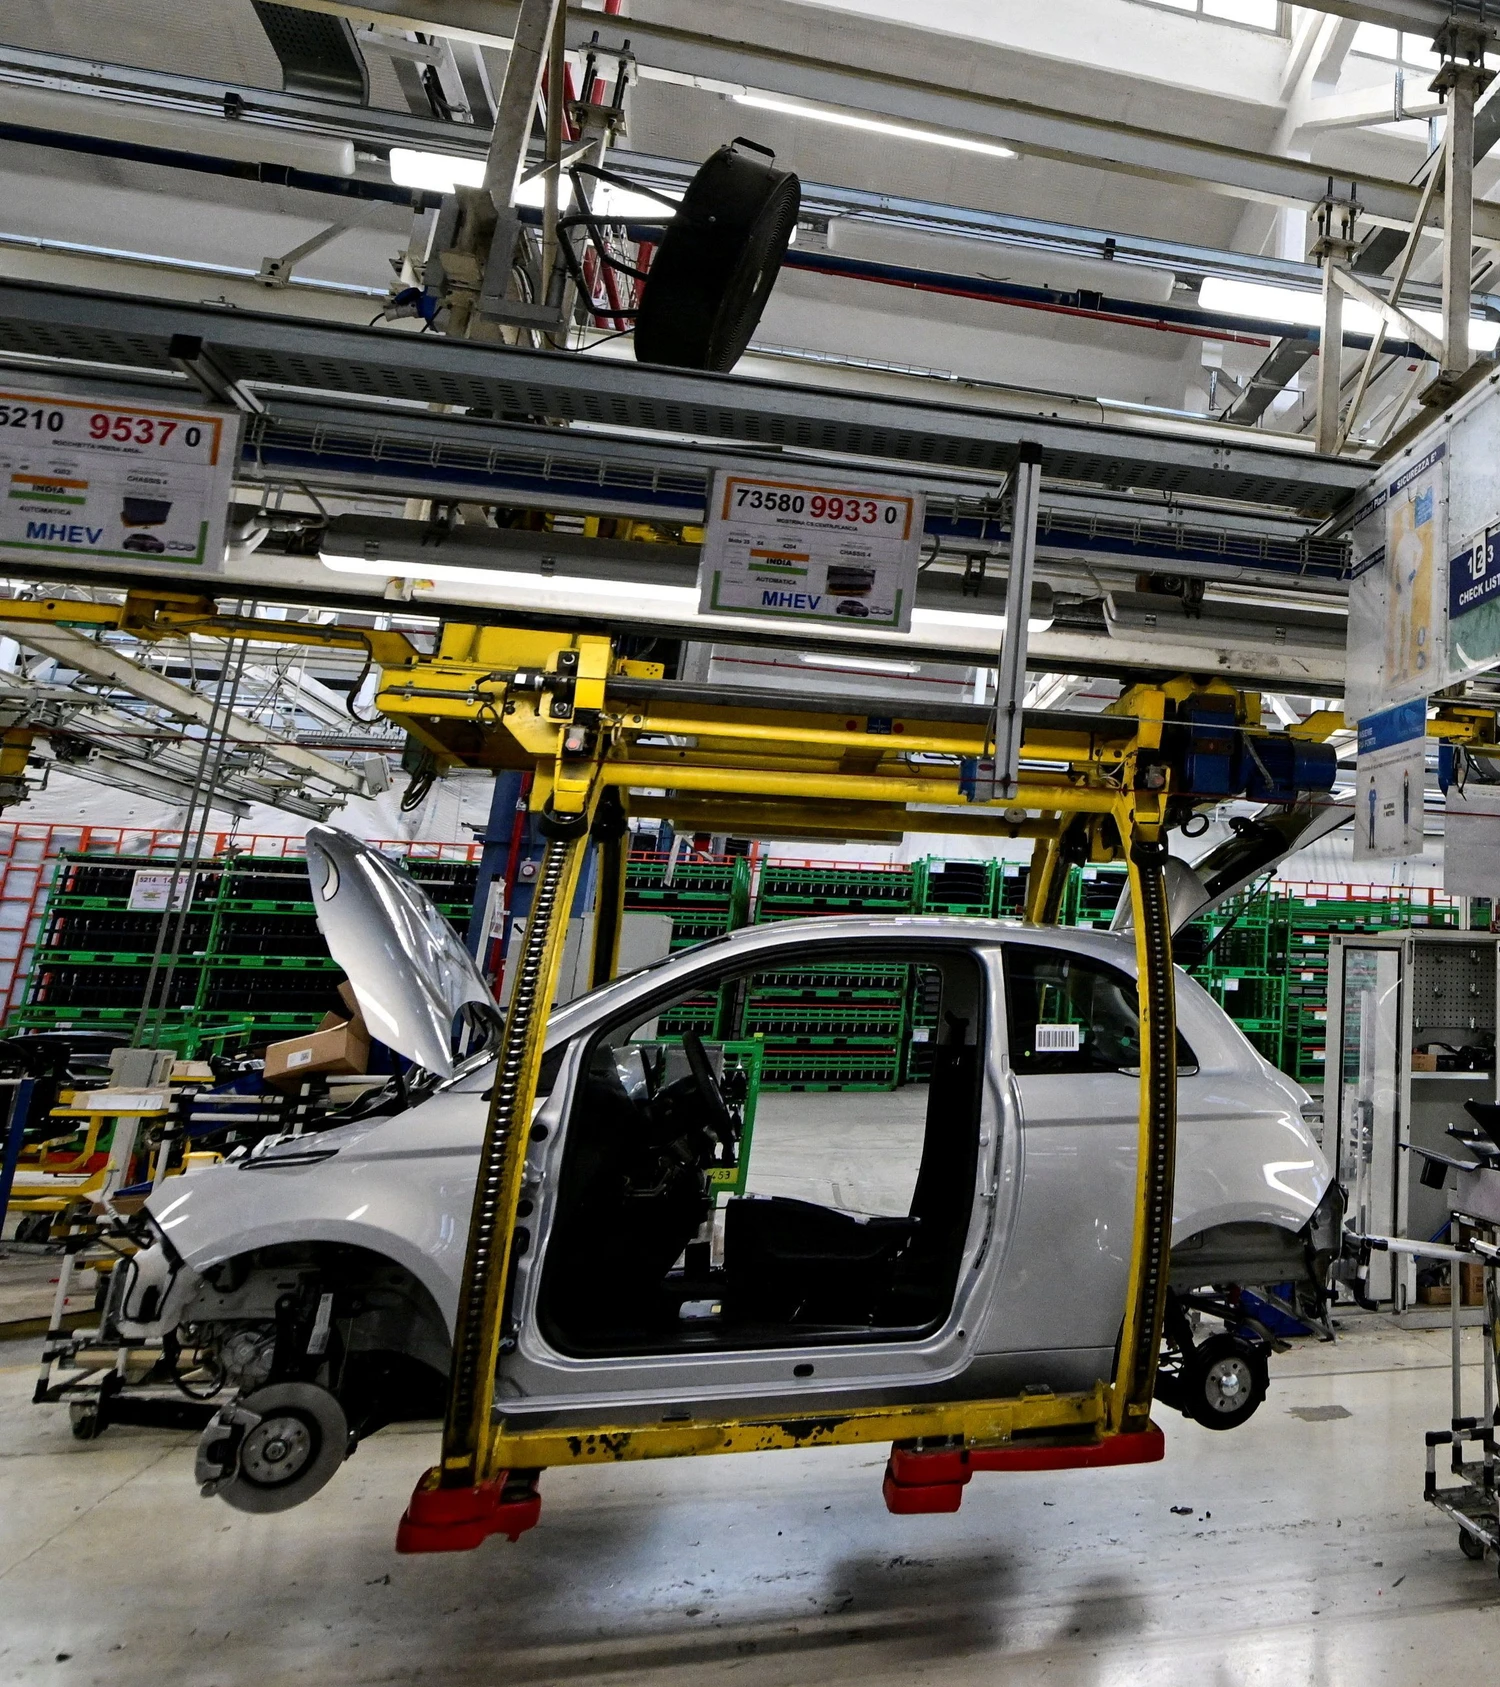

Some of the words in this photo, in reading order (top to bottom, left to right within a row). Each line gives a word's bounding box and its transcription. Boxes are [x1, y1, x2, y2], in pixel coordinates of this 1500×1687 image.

[0, 405, 64, 432] 5210
[89, 414, 177, 447] 9537
[184, 426, 201, 448] 0
[1396, 457, 1429, 490] SICUREZZA
[32, 485, 65, 494] INDIA
[19, 505, 71, 516] AUTOMATICA
[736, 488, 805, 514] 73580
[810, 495, 878, 524] 9933
[884, 506, 897, 524] 0
[26, 521, 103, 544] MHEV
[766, 558, 792, 566] INDIA
[839, 549, 866, 558] CHASSIS
[1487, 544, 1495, 563] 3
[755, 576, 797, 585] AUTOMATICA
[762, 590, 821, 610] MHEV
[1459, 583, 1484, 606] CHECK
